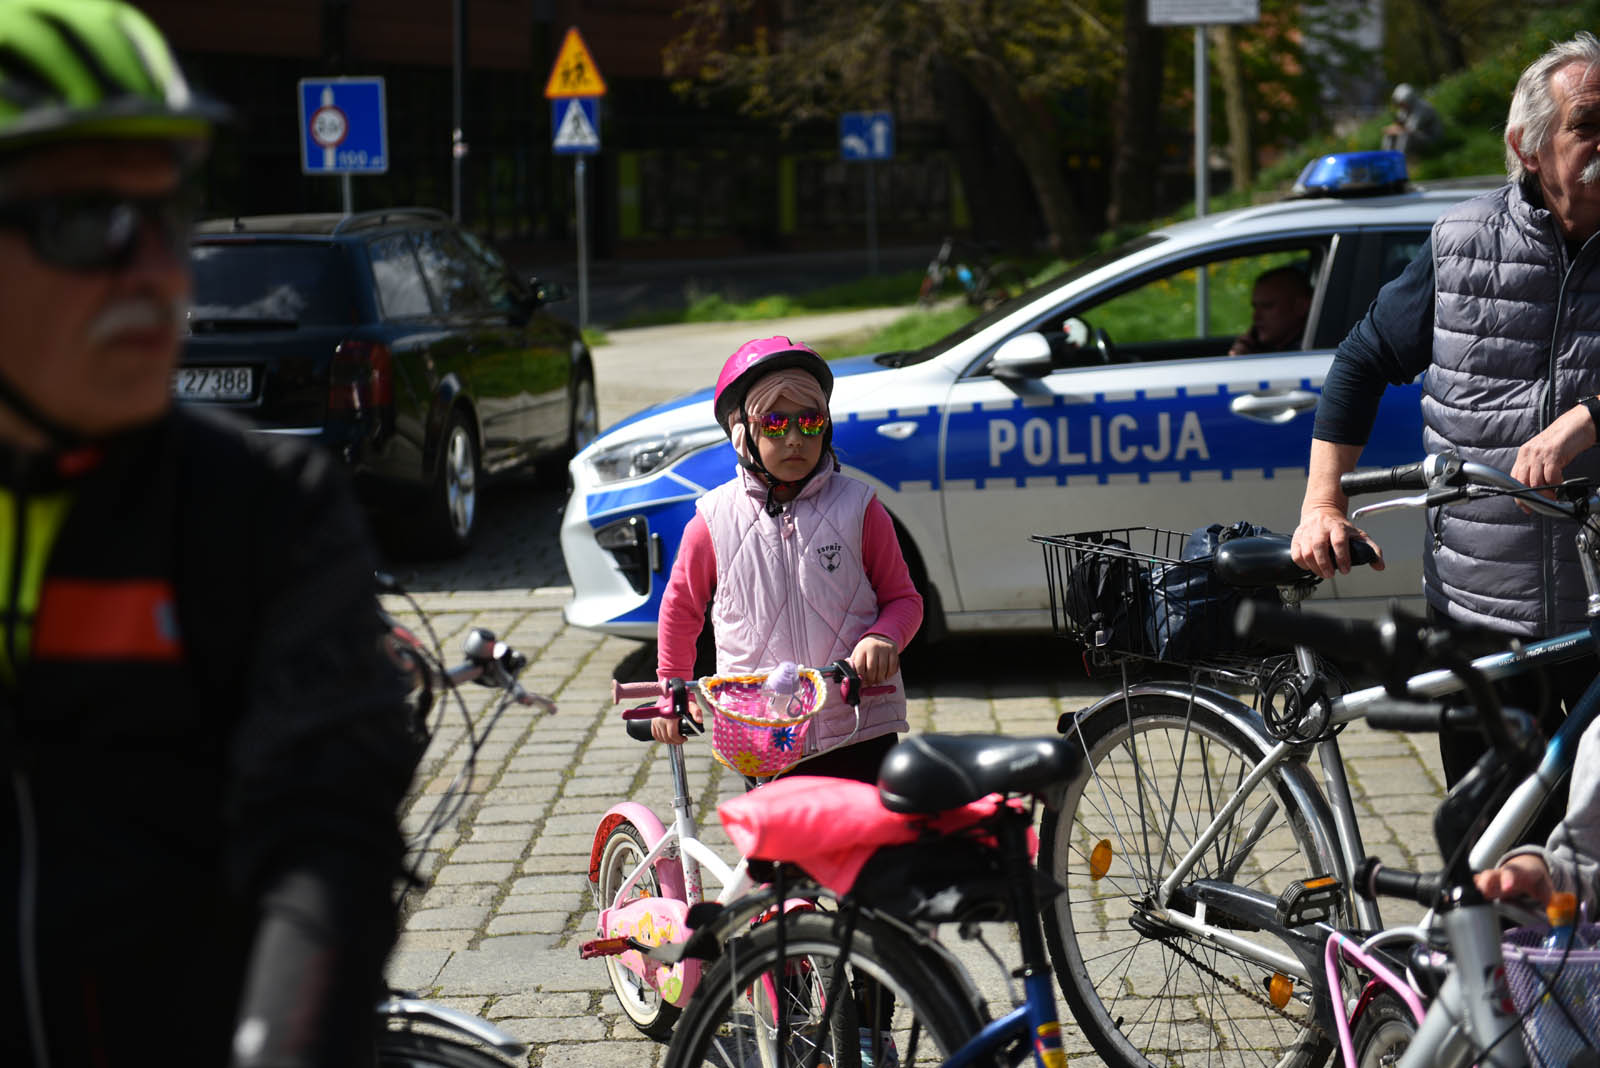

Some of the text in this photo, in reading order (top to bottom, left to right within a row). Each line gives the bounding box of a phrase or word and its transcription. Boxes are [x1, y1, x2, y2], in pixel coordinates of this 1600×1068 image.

[185, 367, 248, 394] 27388
[988, 411, 1211, 467] POLICJA
[1547, 639, 1577, 652] GERMANY
